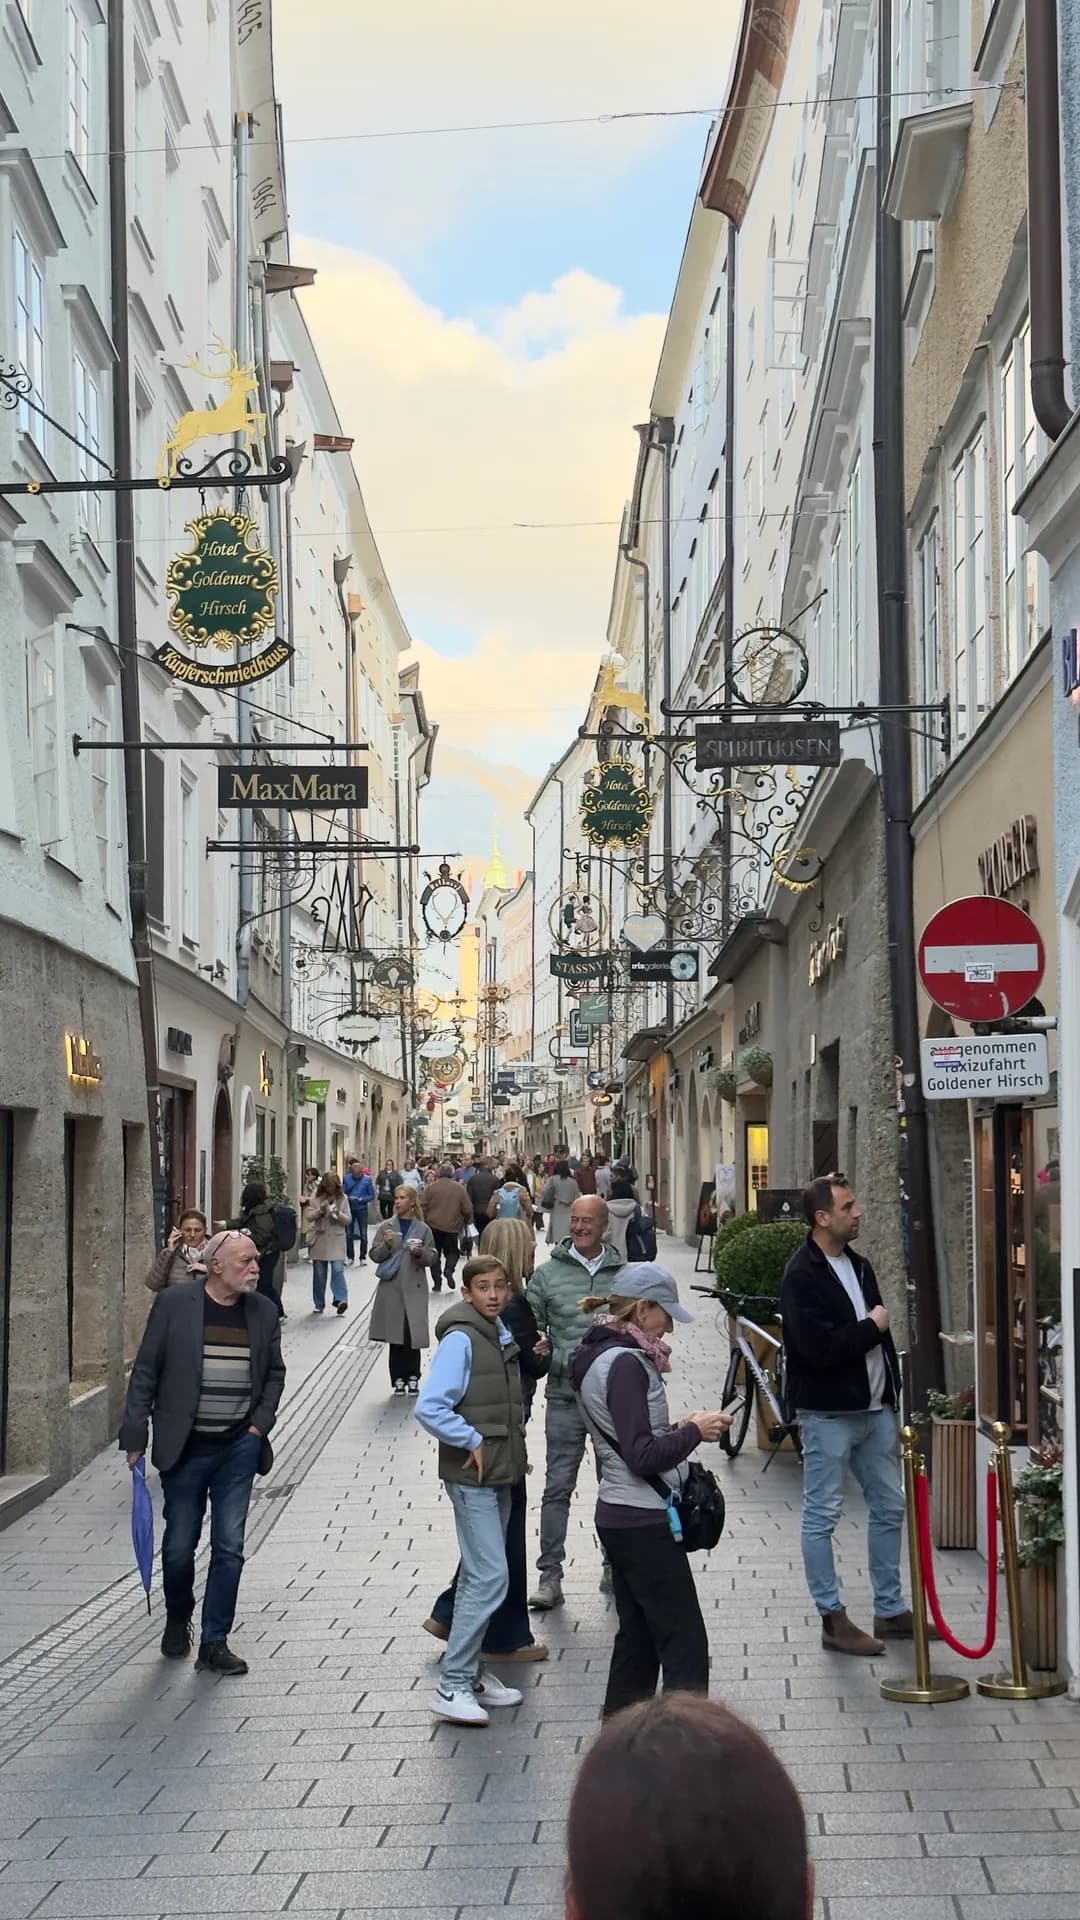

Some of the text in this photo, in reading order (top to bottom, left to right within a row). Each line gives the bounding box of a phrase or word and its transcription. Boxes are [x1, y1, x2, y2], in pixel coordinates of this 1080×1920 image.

[252, 177, 277, 219] 1964
[200, 541, 241, 557] Hotel
[192, 570, 254, 588] Goldener
[200, 600, 247, 616] Hirsch
[158, 644, 289, 685] Kupferschmiedhaus
[706, 738, 832, 758] SPIRITUOSEN
[229, 773, 357, 801] MaxMara
[604, 780, 630, 791] Hotel
[597, 800, 638, 811] Goldener
[601, 820, 632, 831] Hirsch
[555, 960, 603, 975] STASSNY
[927, 1073, 1044, 1091] Goldener Hirsch
